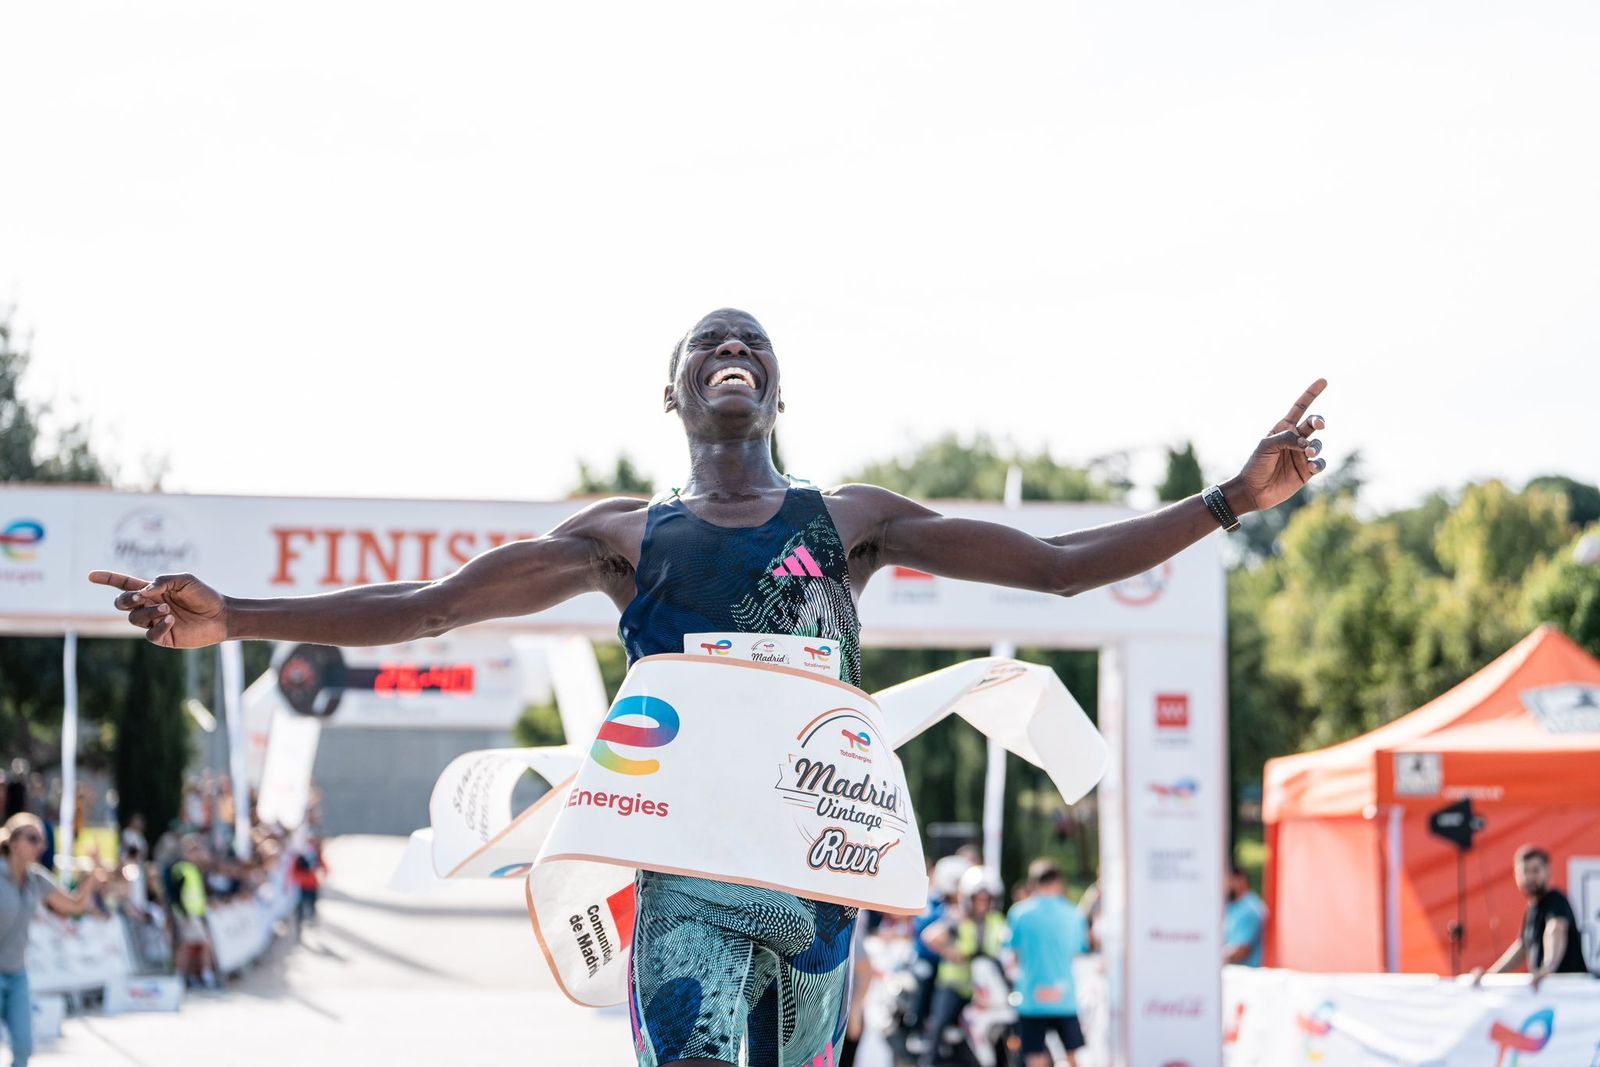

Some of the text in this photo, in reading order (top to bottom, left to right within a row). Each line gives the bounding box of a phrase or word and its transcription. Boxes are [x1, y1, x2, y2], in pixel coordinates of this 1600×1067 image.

[270, 526, 539, 584] FINIS
[751, 653, 786, 663] Madrid
[840, 749, 872, 764] TotalEnergies
[795, 758, 898, 813] Madrid
[564, 787, 669, 818] Energies
[816, 796, 882, 832] Vintage
[808, 826, 881, 877] Run
[569, 914, 584, 932] de
